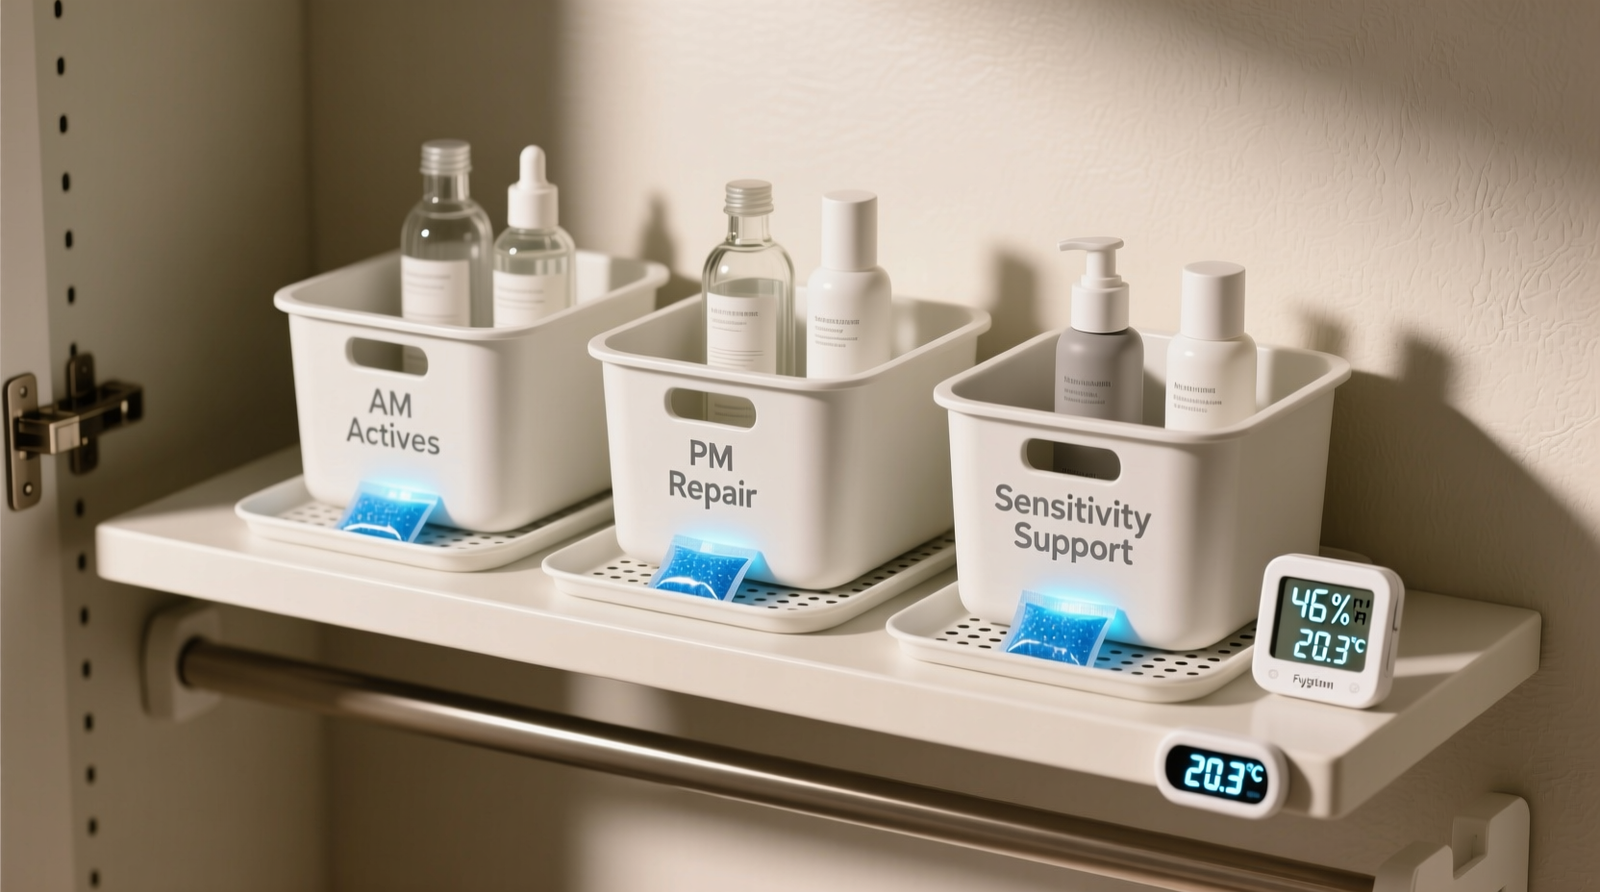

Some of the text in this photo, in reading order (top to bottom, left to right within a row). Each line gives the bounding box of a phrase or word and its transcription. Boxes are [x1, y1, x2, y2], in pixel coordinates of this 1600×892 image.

[369, 388, 412, 418] AM
[346, 416, 440, 455] Actives
[690, 439, 733, 472] PM
[669, 469, 758, 510] Repair
[994, 483, 1152, 539] Sensitivity
[1014, 521, 1134, 565] Support
[1292, 586, 1351, 626] 46%
[1184, 753, 1264, 795] 20.3°C
